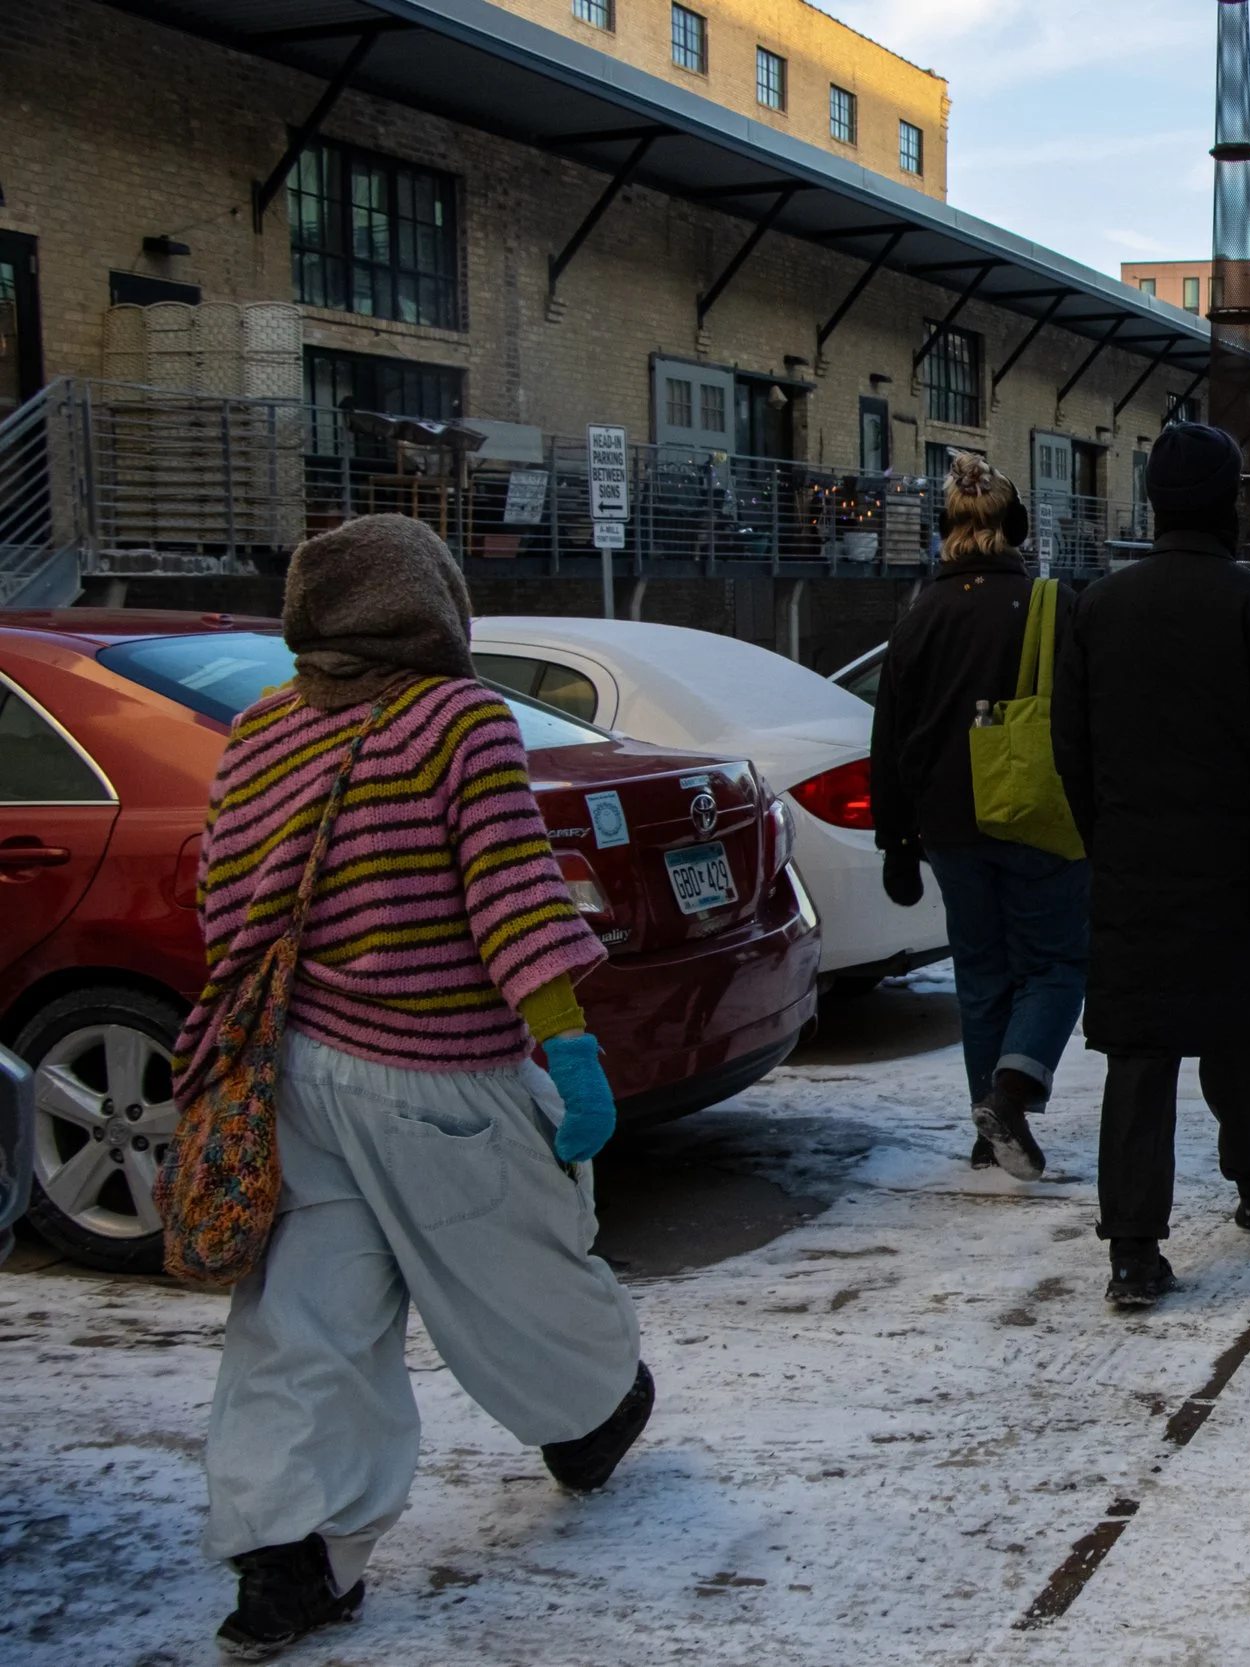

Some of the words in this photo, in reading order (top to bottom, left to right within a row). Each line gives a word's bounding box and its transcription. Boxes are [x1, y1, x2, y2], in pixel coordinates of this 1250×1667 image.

[592, 433, 622, 449] HEAD-IN
[592, 450, 623, 466] PARKING
[592, 467, 625, 482] BETWEEN
[598, 484, 621, 499] SIGNS
[548, 828, 591, 838] AMRY
[706, 860, 729, 891] 429
[600, 929, 631, 942] uality
